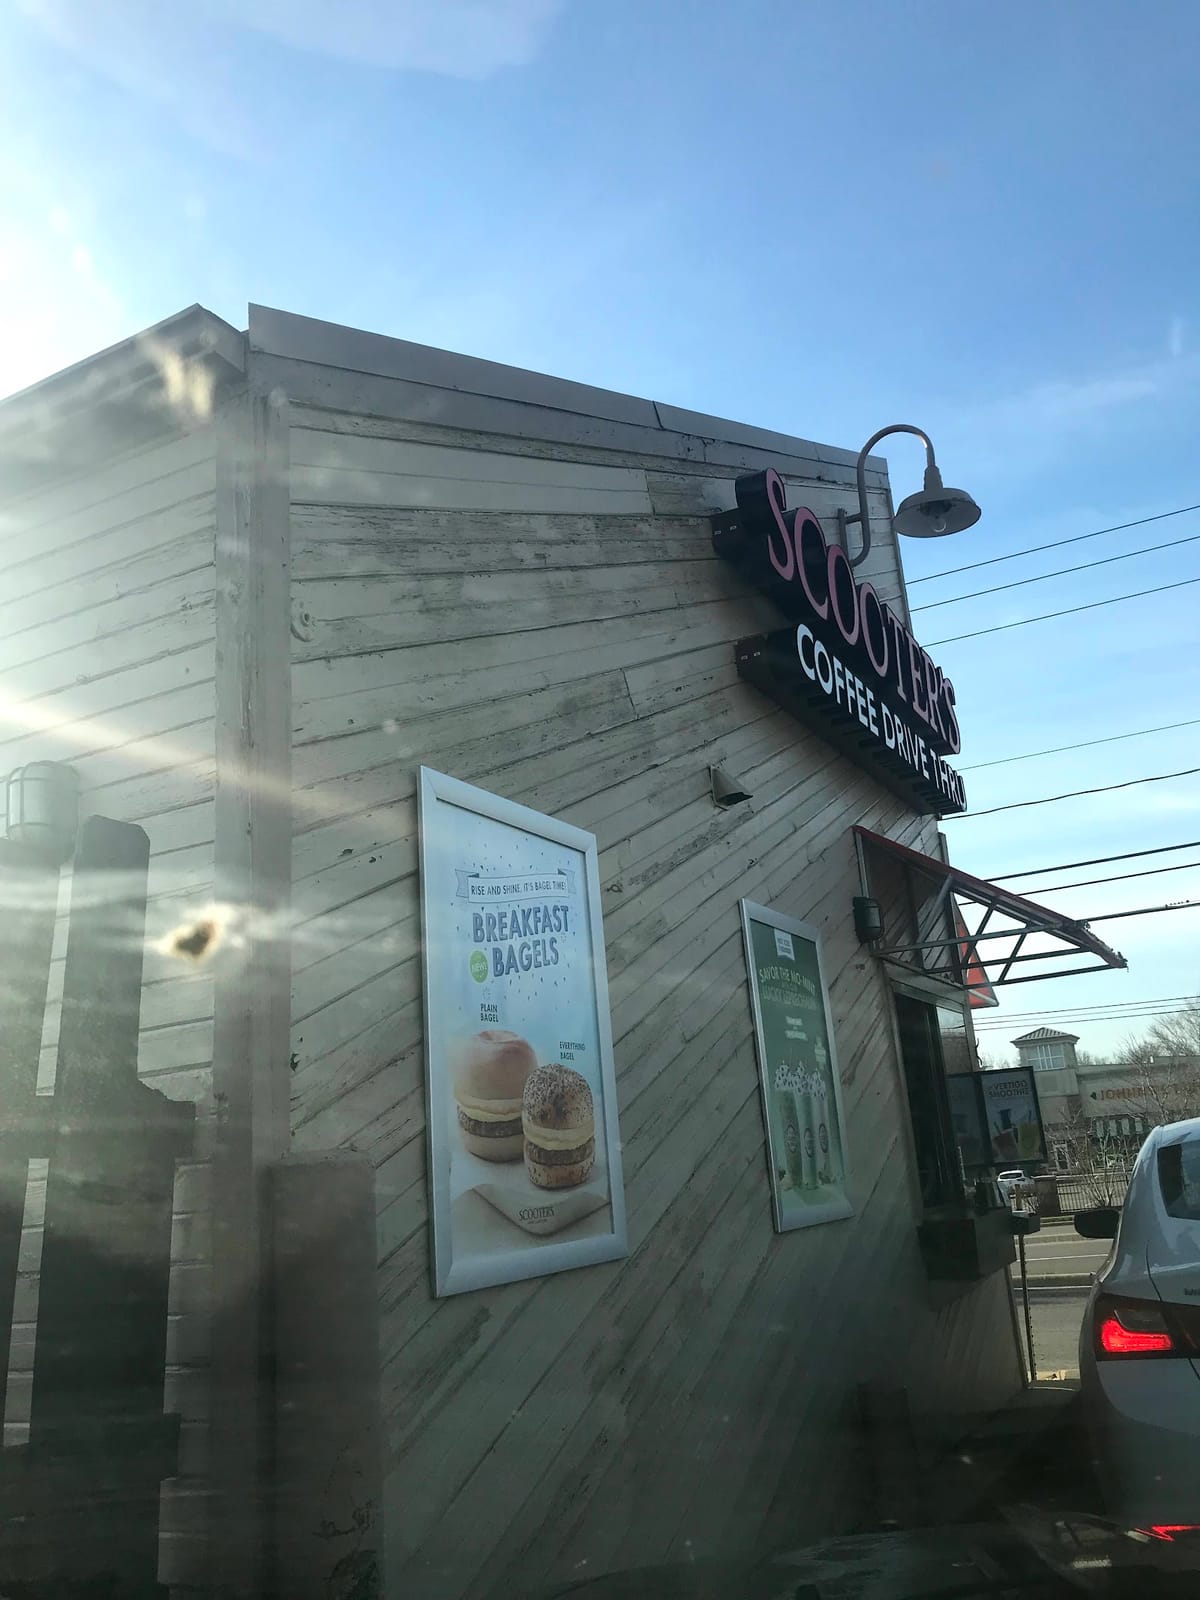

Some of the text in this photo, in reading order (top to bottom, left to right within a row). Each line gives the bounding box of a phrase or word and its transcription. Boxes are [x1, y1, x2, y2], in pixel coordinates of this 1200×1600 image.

[765, 467, 961, 755] SCOOTER'S
[797, 623, 967, 813] COFFEE DRIVE THRU
[471, 885, 486, 896] RISE
[487, 886, 502, 896] AND
[535, 880, 552, 891] BAGEL
[472, 904, 569, 943] BREAKFAST
[492, 937, 559, 977] BAGELS
[759, 966, 780, 983] SAVOR
[480, 1003, 498, 1013] PLAIN
[480, 1013, 499, 1023] BAGEL
[559, 1041, 586, 1051] EVERYTHING
[560, 1052, 575, 1061] BAGEL
